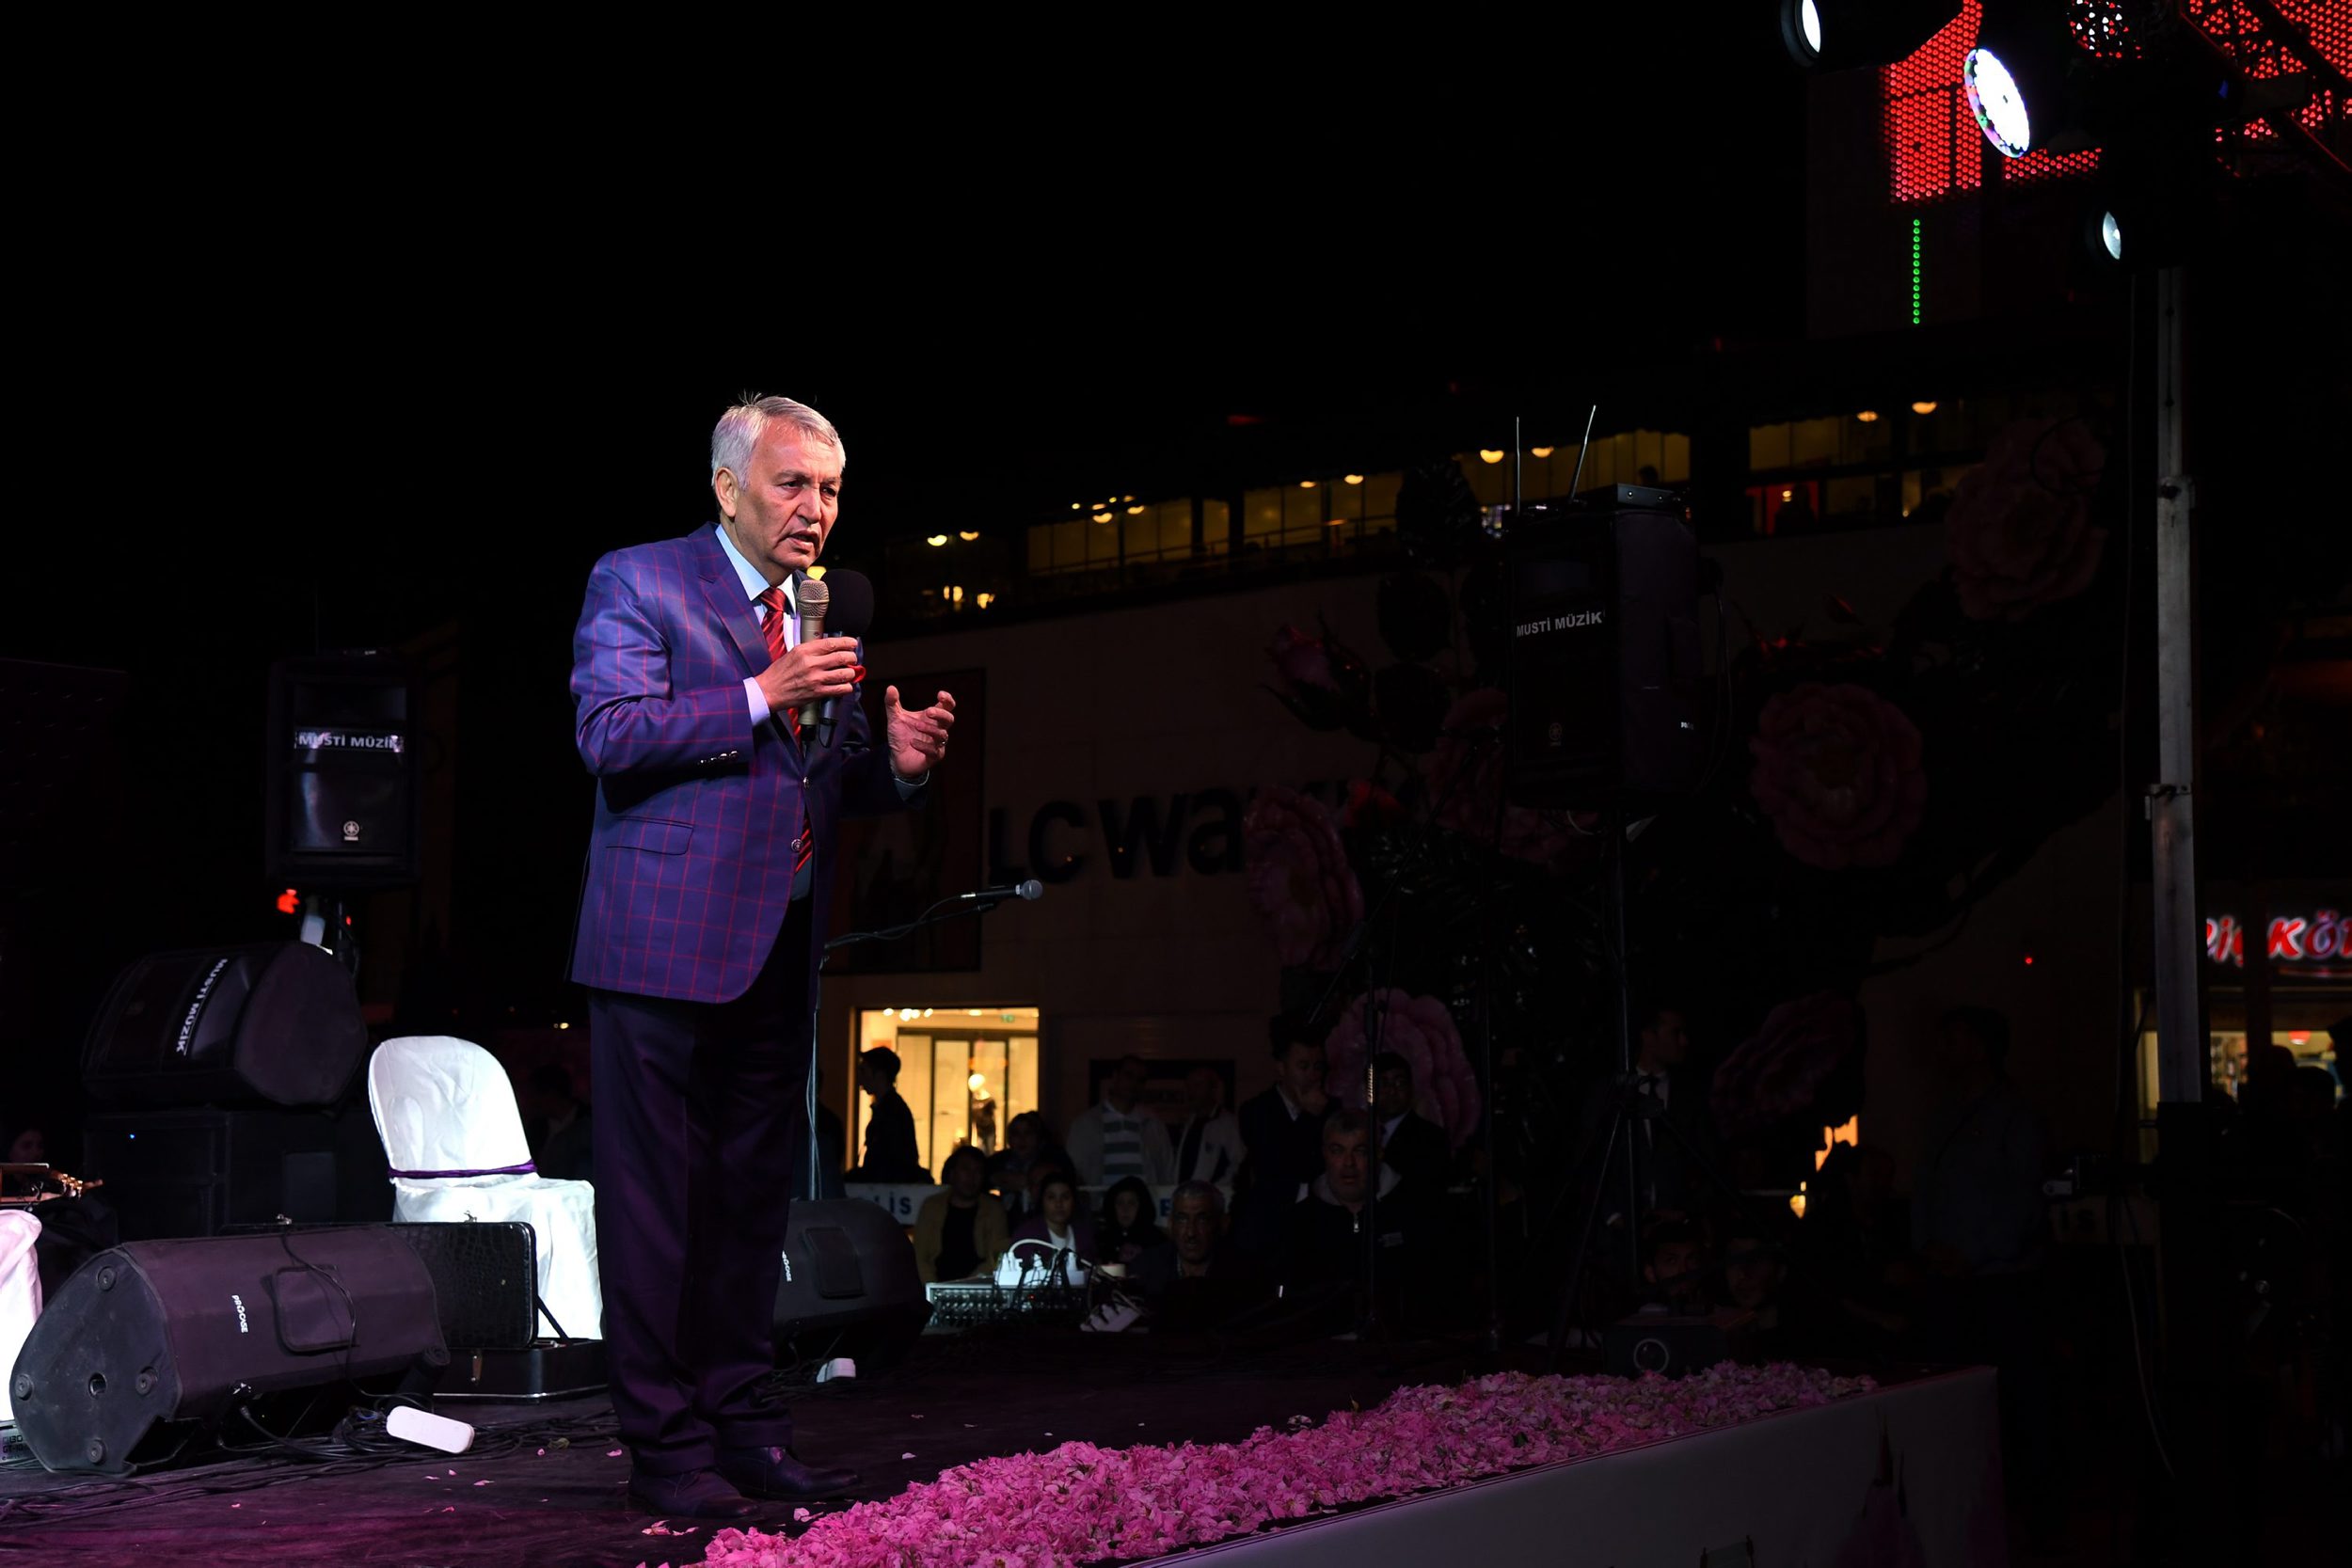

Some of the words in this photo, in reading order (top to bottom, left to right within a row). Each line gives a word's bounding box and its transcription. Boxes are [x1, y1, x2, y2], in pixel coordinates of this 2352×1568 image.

[1517, 617, 1550, 638] MUSTİ
[1555, 610, 1602, 630] MÜZİK
[298, 734, 345, 749] MUSTİ
[350, 736, 401, 752] MÜZİK
